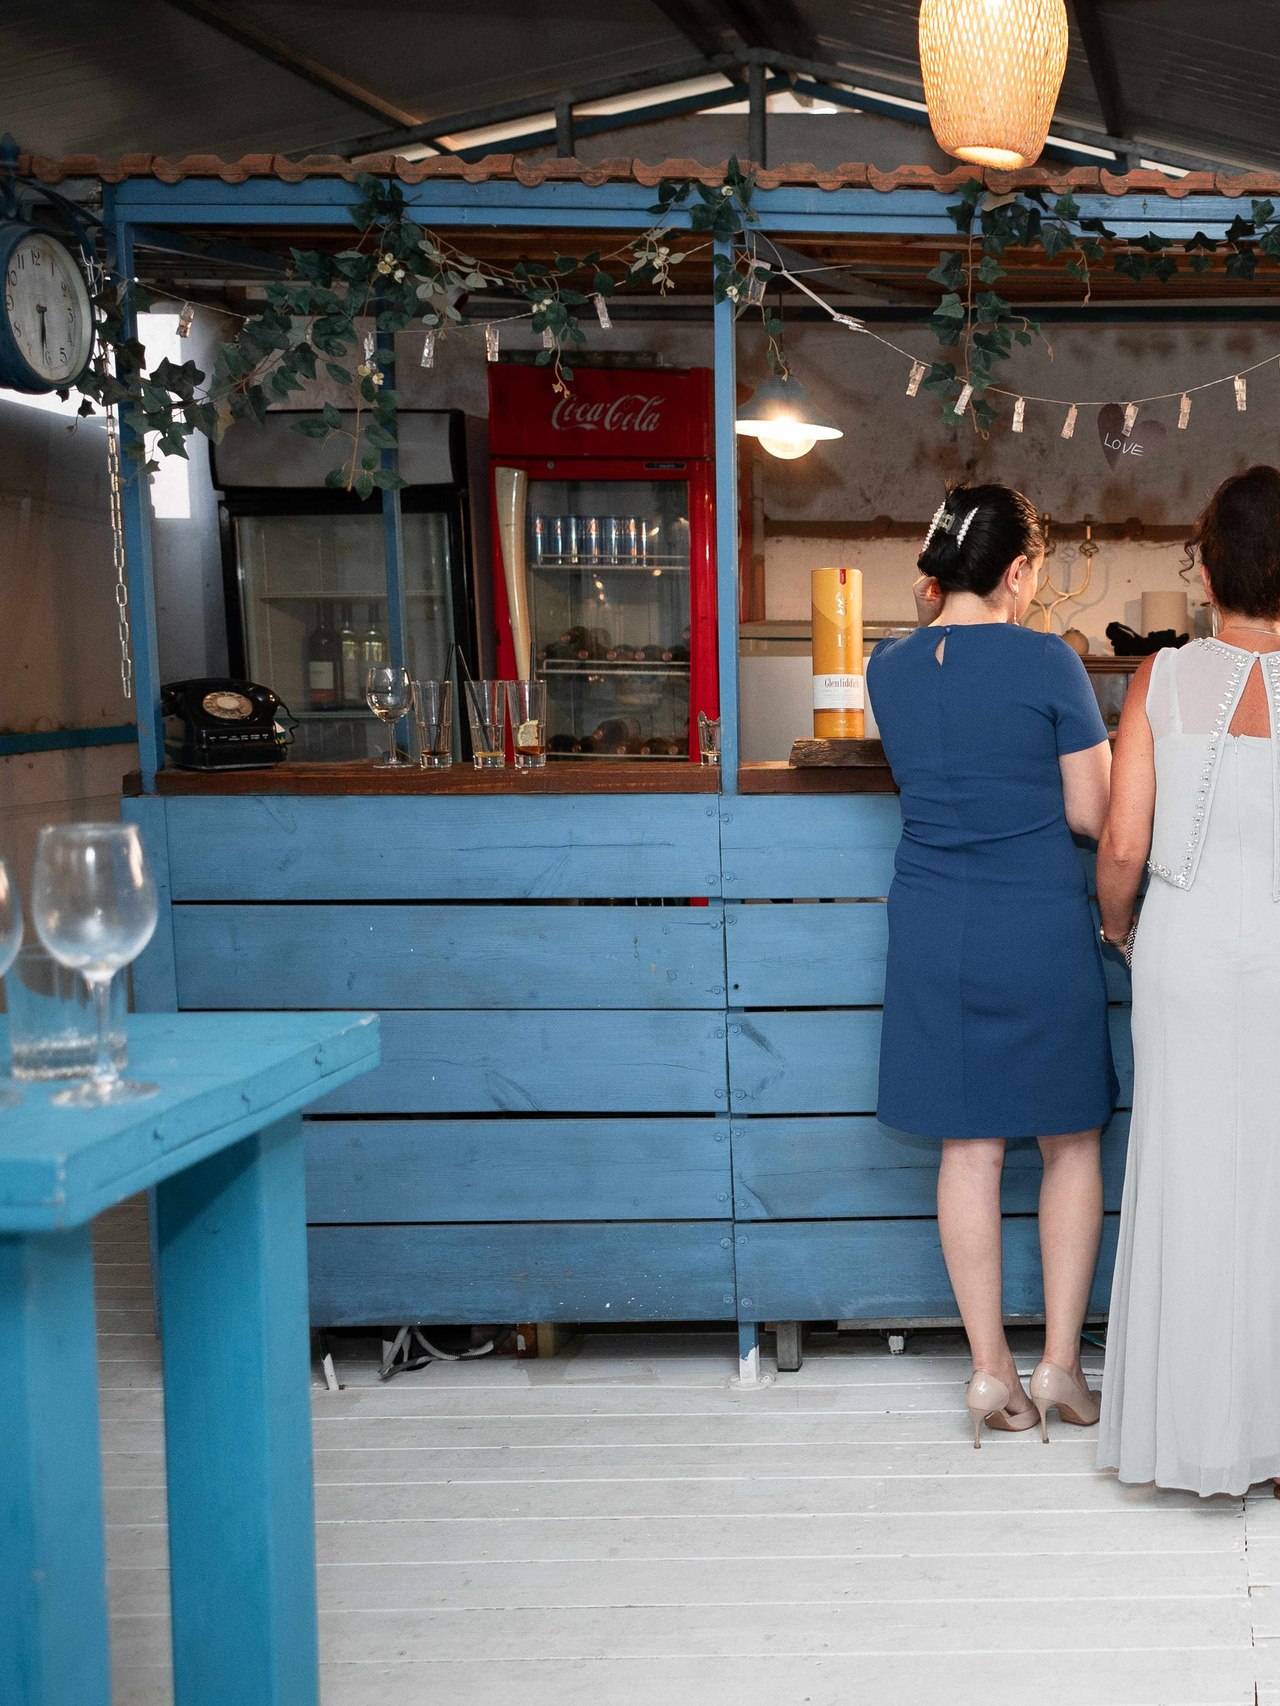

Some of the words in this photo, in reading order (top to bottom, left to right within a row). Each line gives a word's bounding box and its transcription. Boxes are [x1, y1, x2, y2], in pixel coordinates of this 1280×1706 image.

[17, 253, 25, 270] 11
[31, 249, 41, 266] 12
[7, 269, 18, 287] 10
[551, 394, 665, 431] Coca-Cola
[1104, 432, 1144, 457] LOVE
